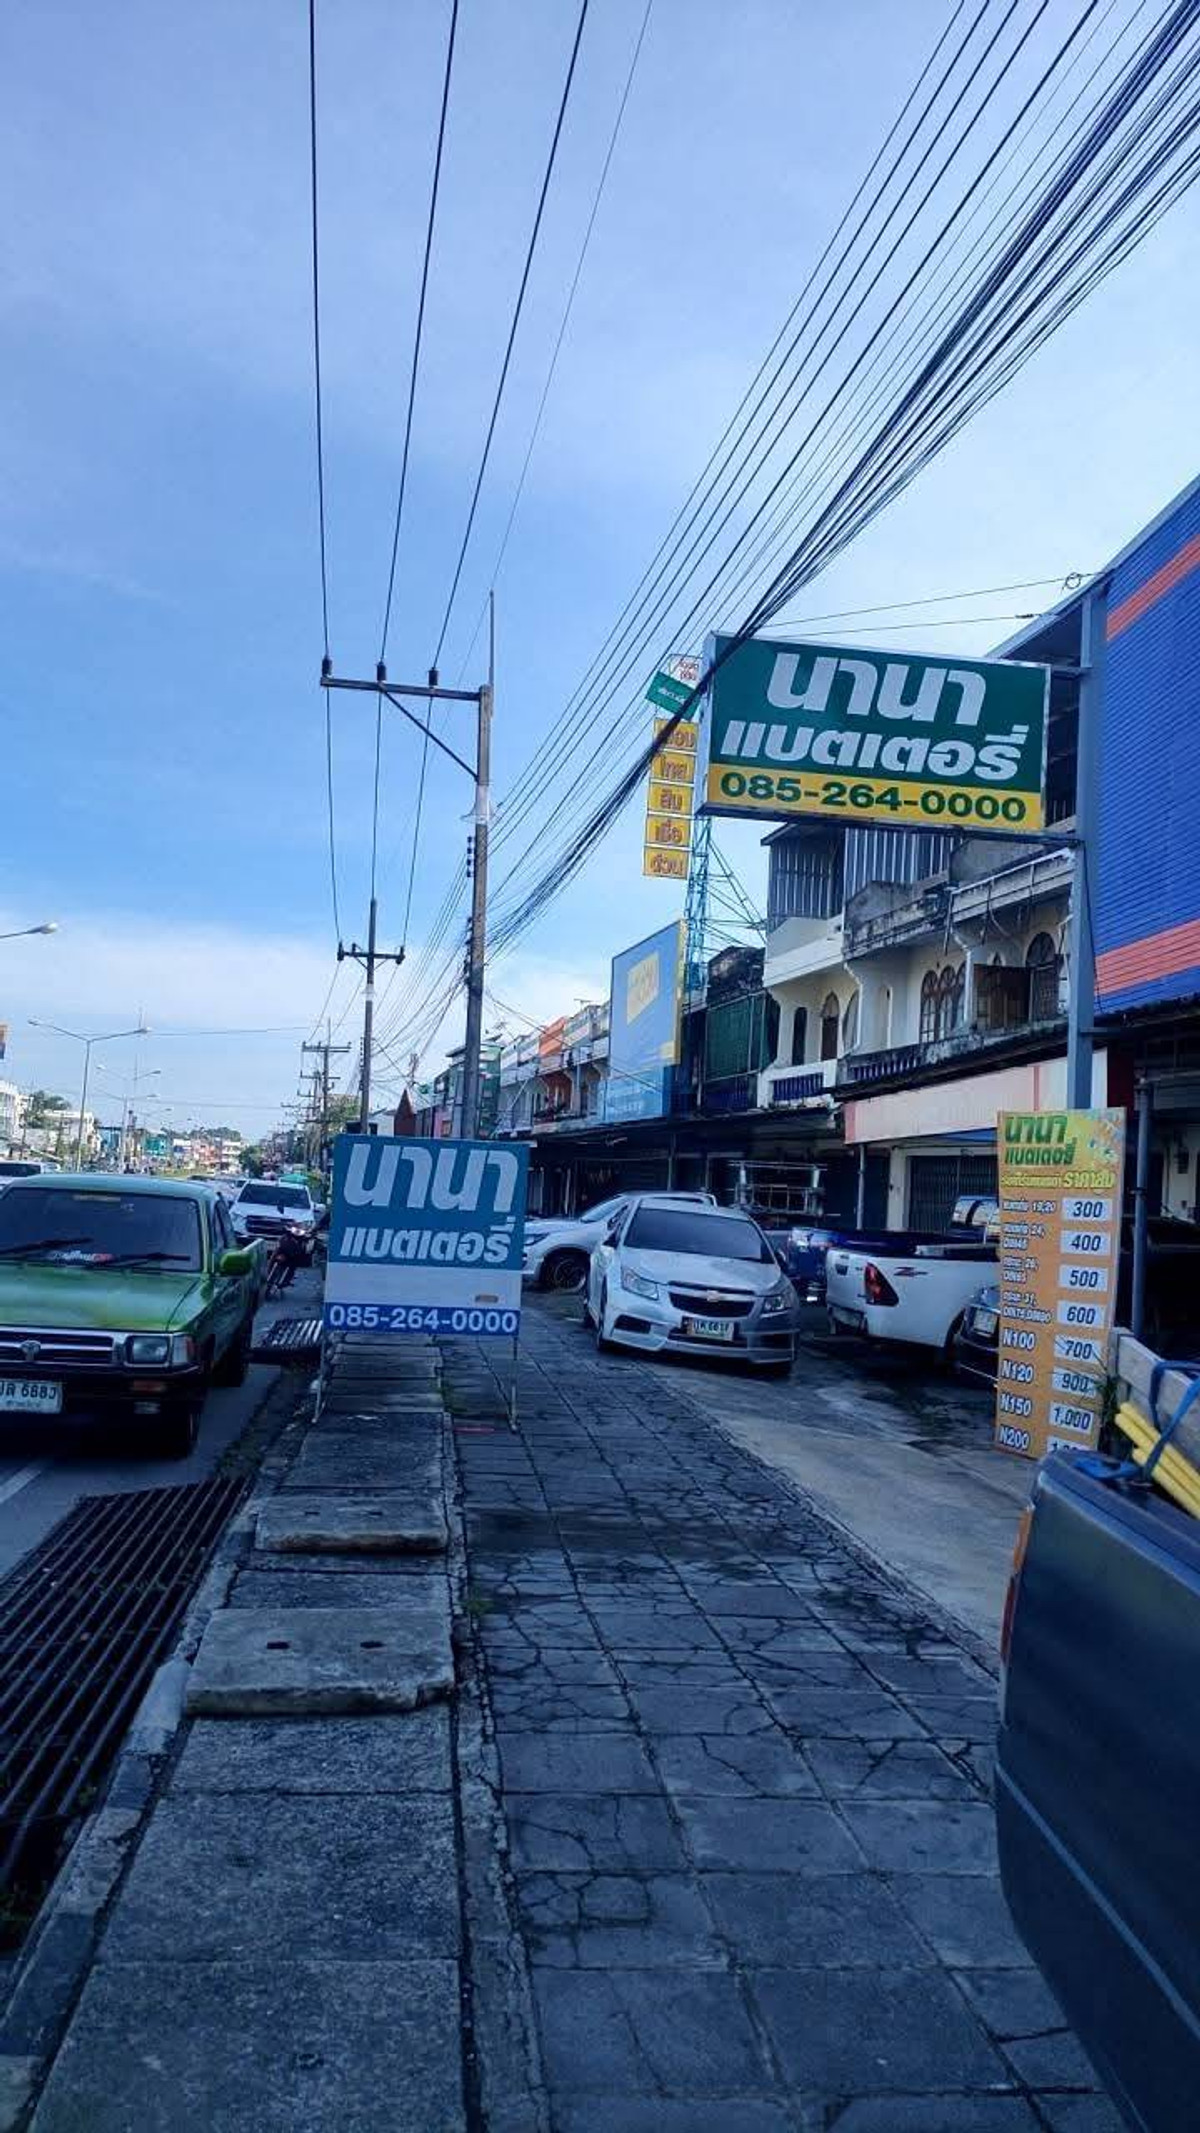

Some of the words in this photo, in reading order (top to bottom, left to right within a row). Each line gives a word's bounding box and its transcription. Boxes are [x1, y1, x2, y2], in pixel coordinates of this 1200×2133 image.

[766, 653, 986, 726] นานา
[720, 720, 1029, 781] แบตเตอรี่
[720, 772, 1026, 822] 085-264-0000
[1005, 1116, 1068, 1143] นานา
[1005, 1137, 1078, 1165] แบตเตอรี่
[343, 1143, 519, 1212] นานา
[1073, 1201, 1103, 1218] 300
[340, 1216, 516, 1263] แบตเตอรี่
[1071, 1235, 1101, 1251] 400
[1069, 1270, 1099, 1288] 500
[330, 1306, 518, 1333] 085-264-0000
[1067, 1306, 1096, 1324] 600
[1003, 1328, 1036, 1351] N100
[1065, 1340, 1092, 1359] 700
[1002, 1360, 1034, 1384] N120
[1062, 1373, 1089, 1392] 900
[1001, 1392, 1032, 1417] N150
[1054, 1407, 1091, 1430] 1,000
[999, 1424, 1030, 1450] N200
